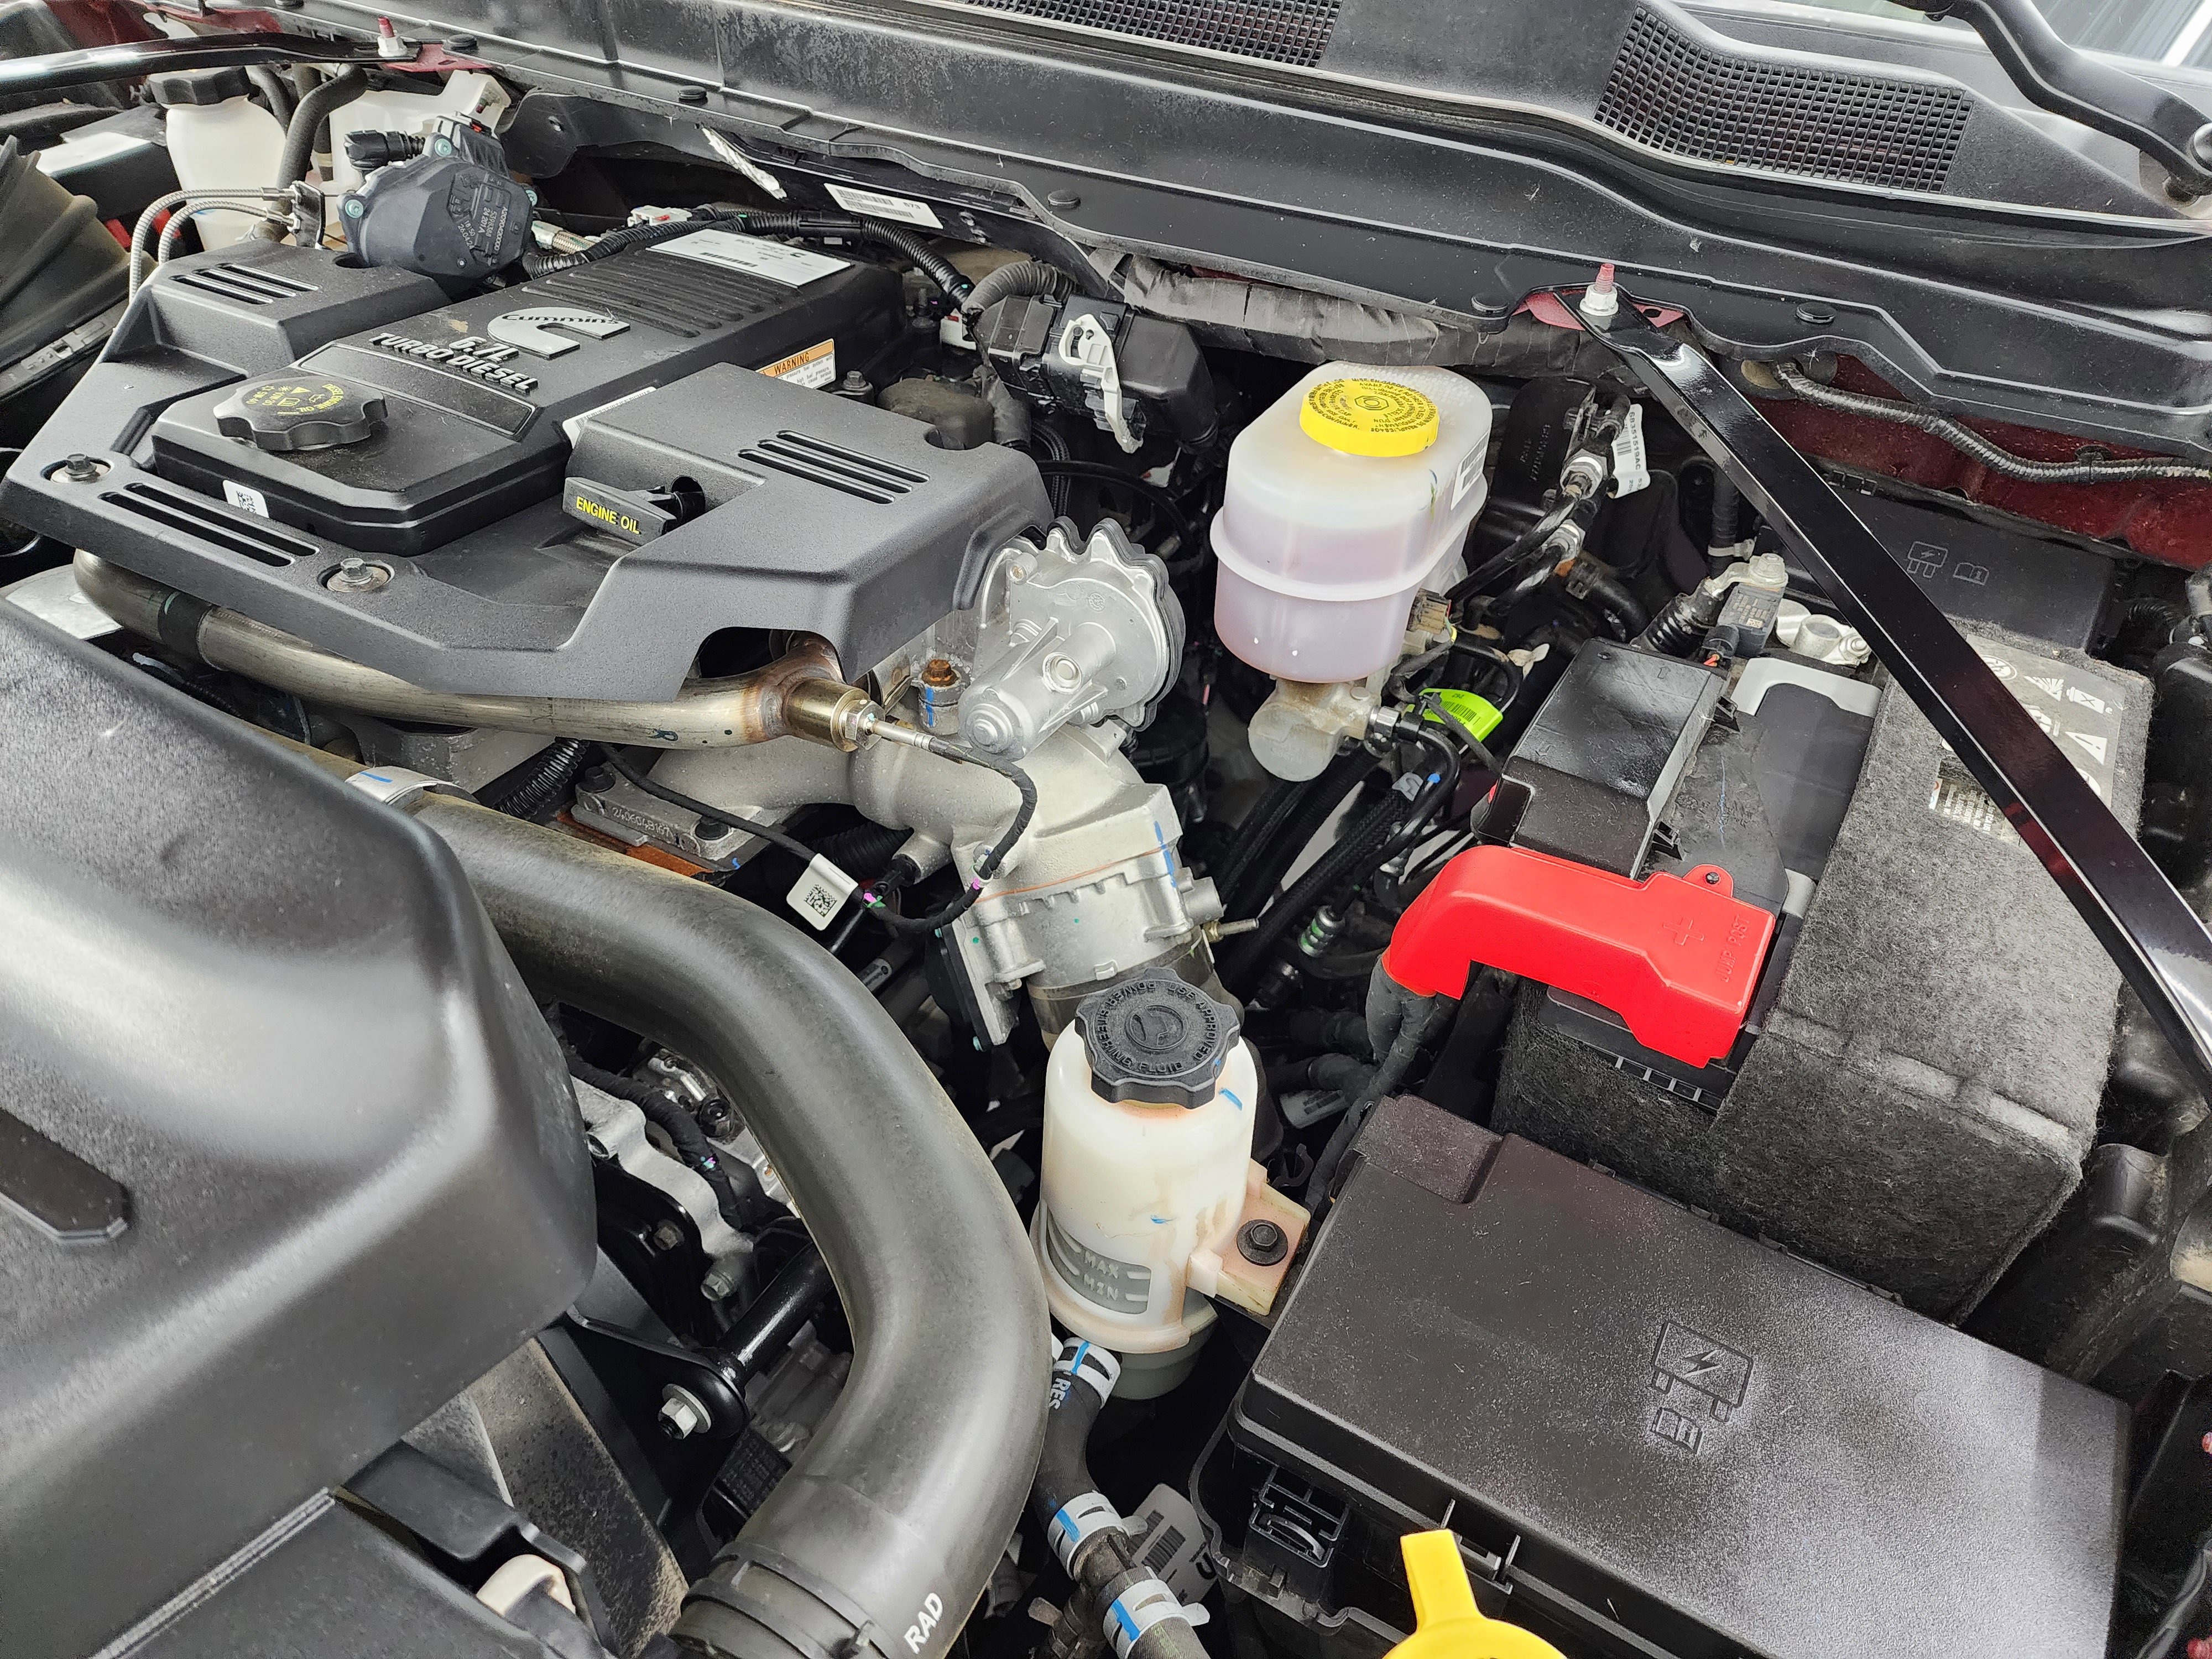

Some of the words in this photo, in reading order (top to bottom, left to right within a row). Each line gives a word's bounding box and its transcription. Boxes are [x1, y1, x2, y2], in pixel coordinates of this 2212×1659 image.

[502, 313, 619, 325] Cummins
[368, 333, 454, 361] TURBO
[446, 356, 538, 394] DIESEL
[448, 335, 519, 363] 6.7L
[774, 352, 809, 374] WARNING
[1629, 411, 1641, 470] 68351519AC
[576, 496, 617, 524] ENGINE
[620, 515, 640, 535] OIL
[1716, 950, 1735, 982] JUMP
[1726, 914, 1749, 946] POST
[1106, 982, 1157, 1006] POWER
[1167, 983, 1196, 1000] USE
[1097, 1008, 1133, 1069] STEERING
[1192, 1000, 1217, 1062] APPROVED
[1138, 1061, 1185, 1074] FLUID
[1084, 1250, 1119, 1279] MAX
[1083, 1274, 1118, 1300] MIN
[1048, 1378, 1071, 1410] RES
[903, 1593, 943, 1654] RAD
